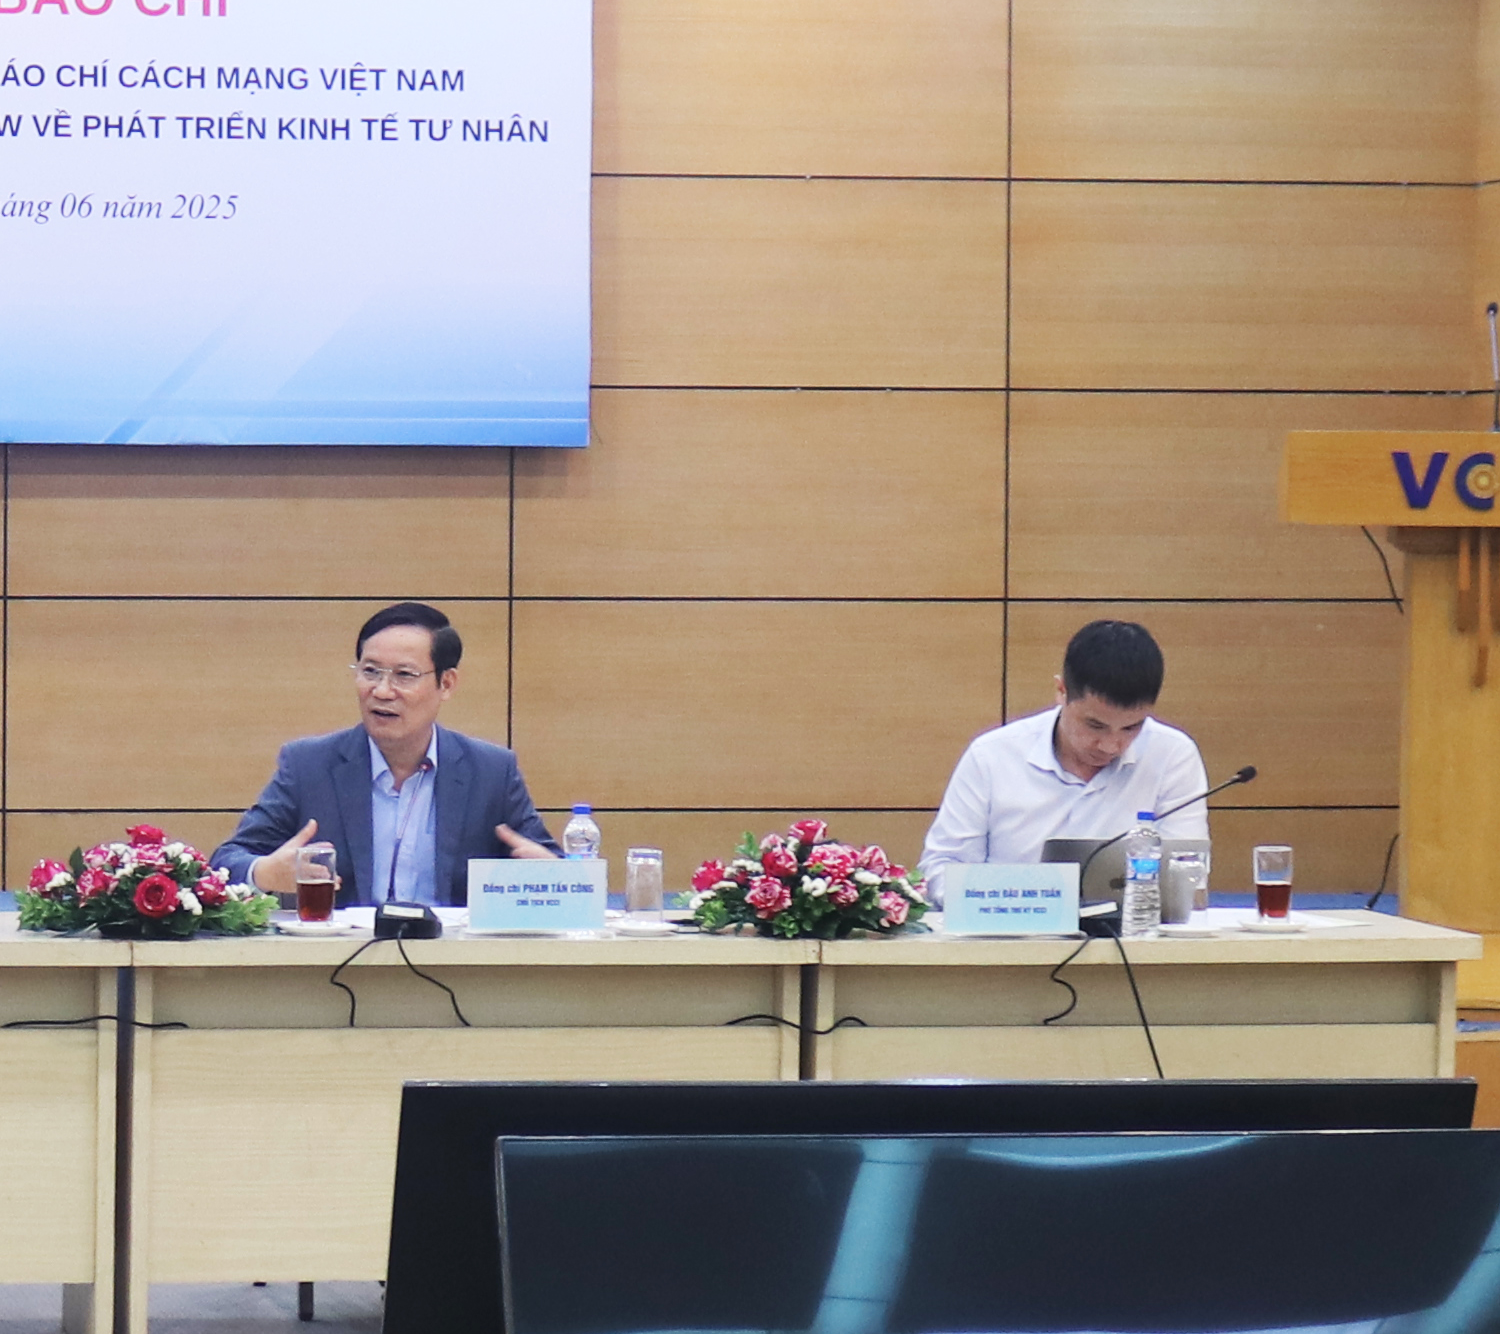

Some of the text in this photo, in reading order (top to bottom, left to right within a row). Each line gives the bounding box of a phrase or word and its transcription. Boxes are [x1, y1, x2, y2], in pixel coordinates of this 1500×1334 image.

[55, 58, 108, 88] CHÍ
[118, 59, 206, 89] CÁCH
[217, 66, 309, 95] MẠNG
[319, 61, 387, 97] VIỆT
[397, 68, 464, 92] NAM
[31, 108, 73, 138] VỀ
[83, 109, 167, 139] PHÁT
[175, 111, 267, 140] TRIỂN
[278, 117, 350, 141] KINH
[360, 113, 399, 141] TẾ
[408, 118, 453, 142] TƯ
[462, 113, 549, 143] NHÂN
[60, 194, 93, 218] 06
[103, 195, 162, 219] năm
[170, 194, 238, 220] 2025
